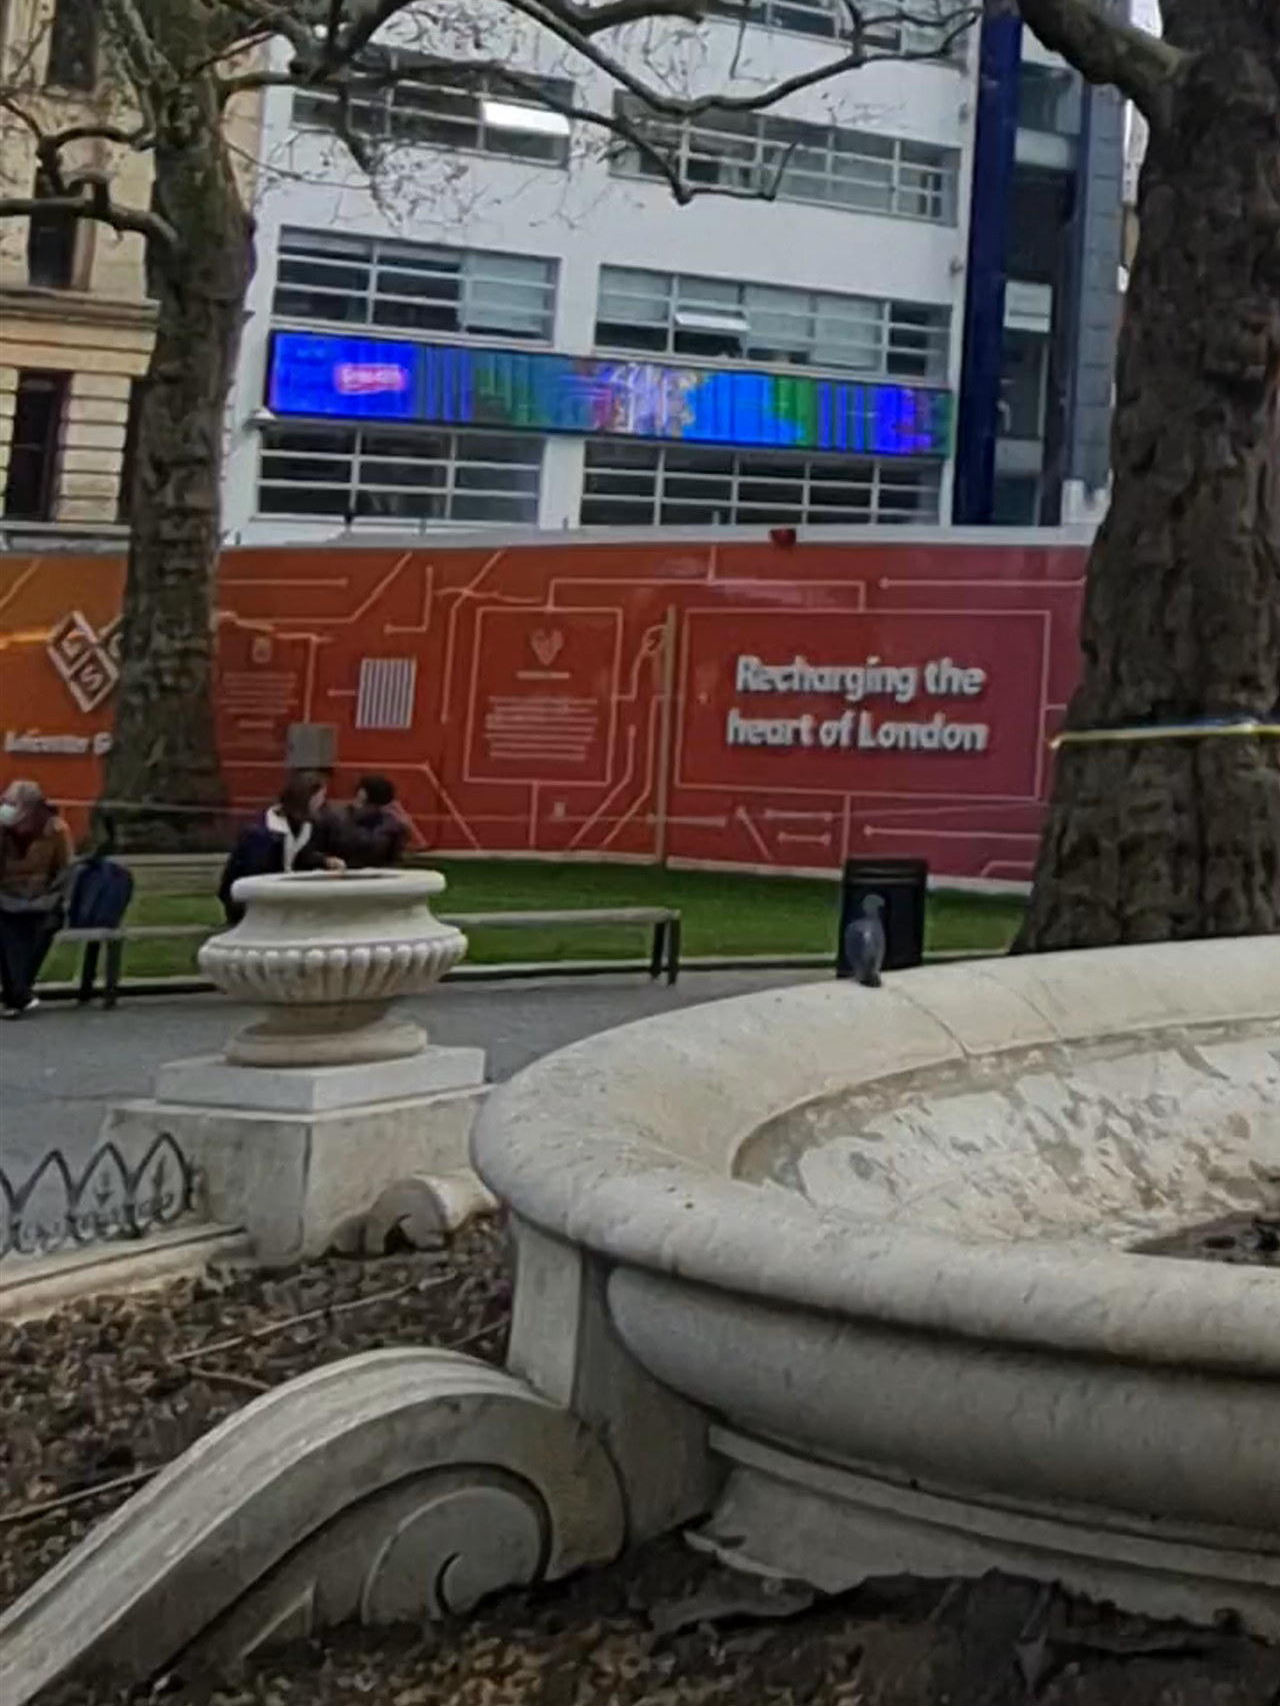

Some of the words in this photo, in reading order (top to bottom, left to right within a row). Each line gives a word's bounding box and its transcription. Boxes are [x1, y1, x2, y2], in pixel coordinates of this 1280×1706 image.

[736, 654, 918, 703] Recharging
[924, 657, 987, 695] the
[726, 707, 814, 747] heart
[818, 709, 855, 749] of
[858, 710, 990, 751] London
